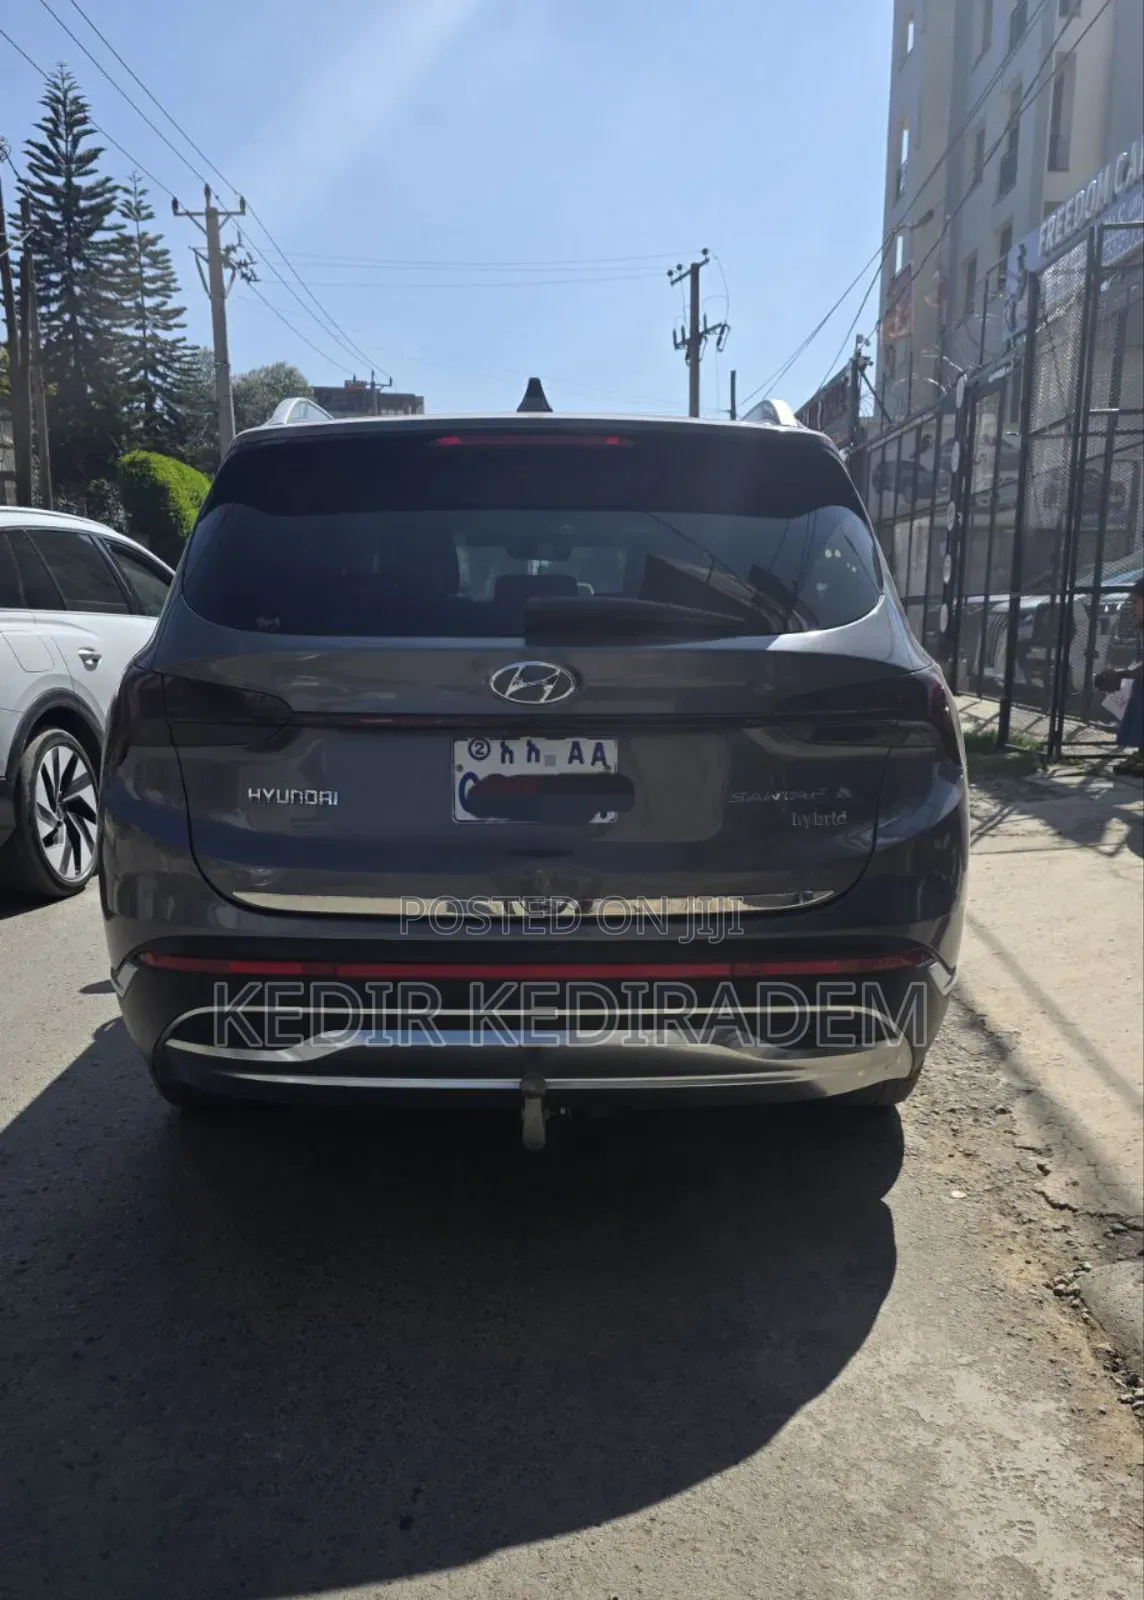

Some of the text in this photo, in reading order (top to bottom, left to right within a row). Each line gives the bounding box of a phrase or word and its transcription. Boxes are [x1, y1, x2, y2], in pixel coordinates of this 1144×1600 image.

[1039, 164, 1112, 257] FREEDOM
[567, 739, 610, 768] AA
[248, 788, 338, 806] HYUNDAI
[791, 811, 848, 829] hybrid
